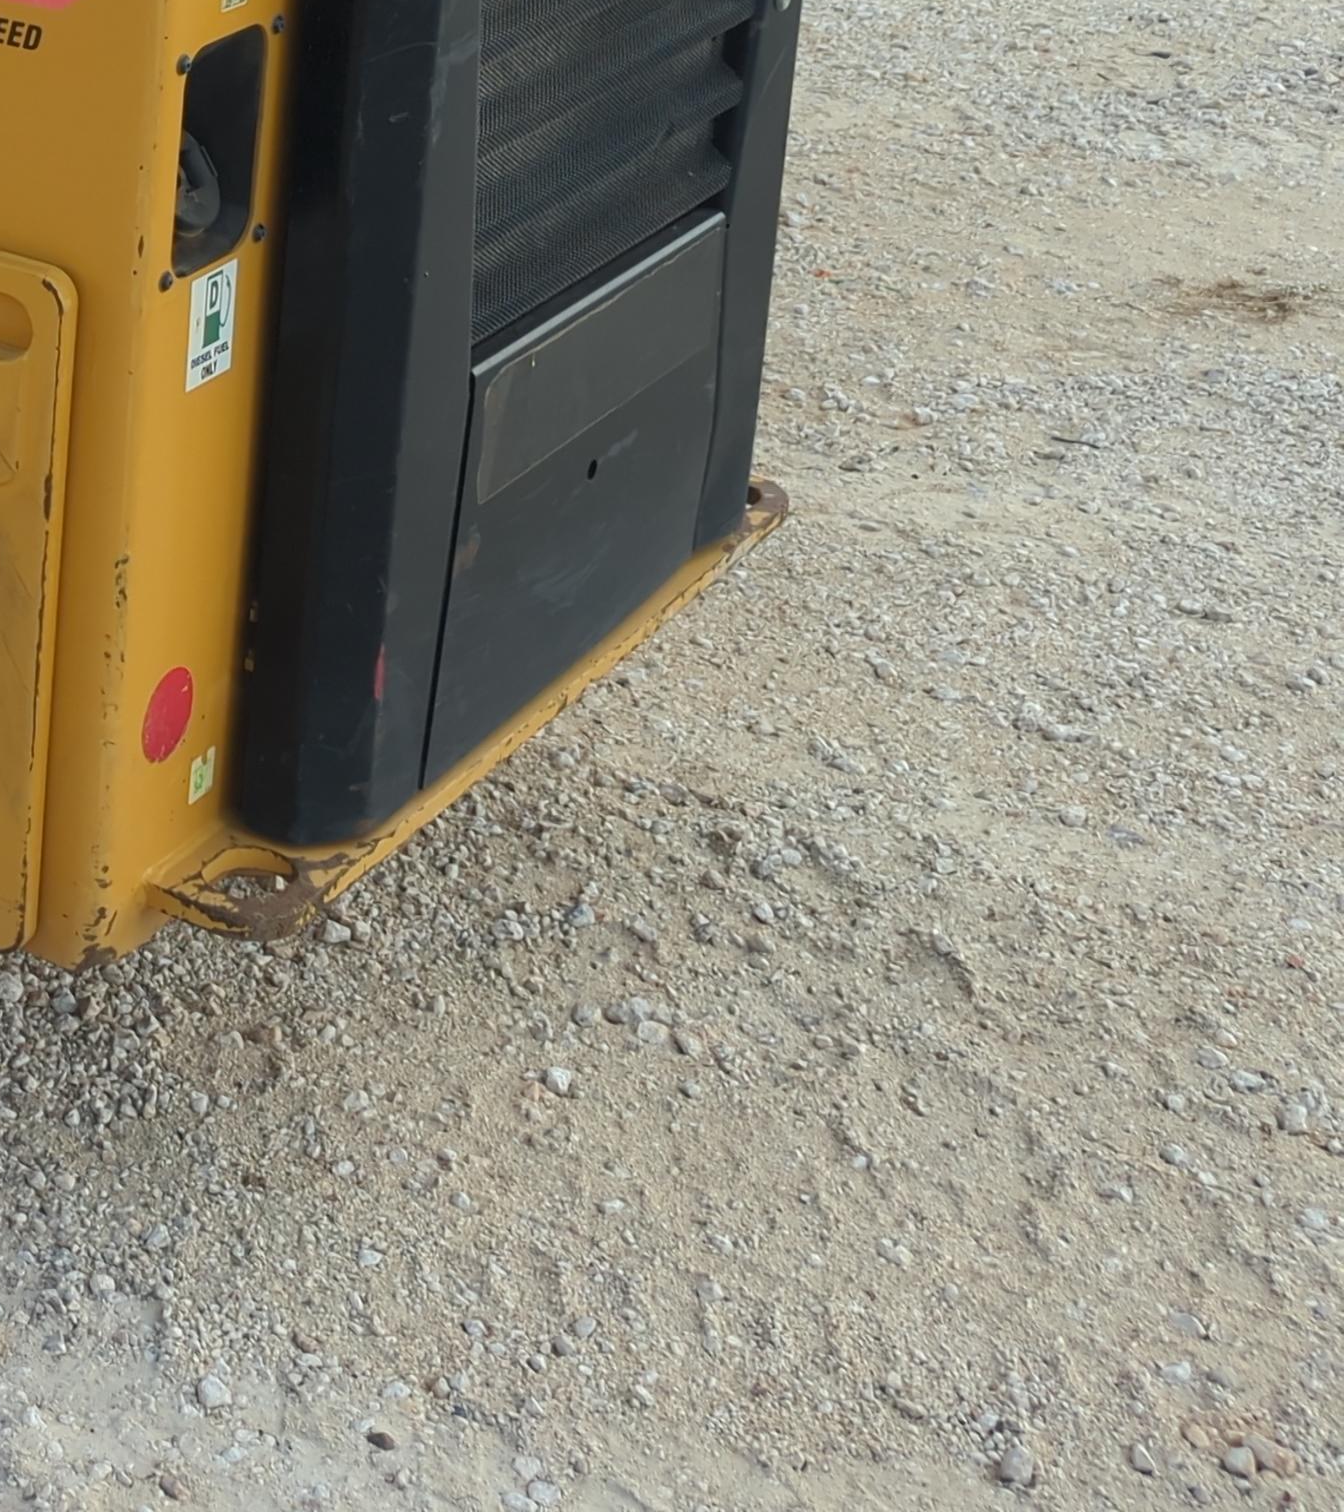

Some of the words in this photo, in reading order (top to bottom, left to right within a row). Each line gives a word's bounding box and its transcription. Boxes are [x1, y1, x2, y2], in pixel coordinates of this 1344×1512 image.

[209, 280, 219, 309] D
[191, 349, 212, 370] DIESEL
[213, 341, 230, 358] FUEL
[201, 359, 217, 379] ONLY
